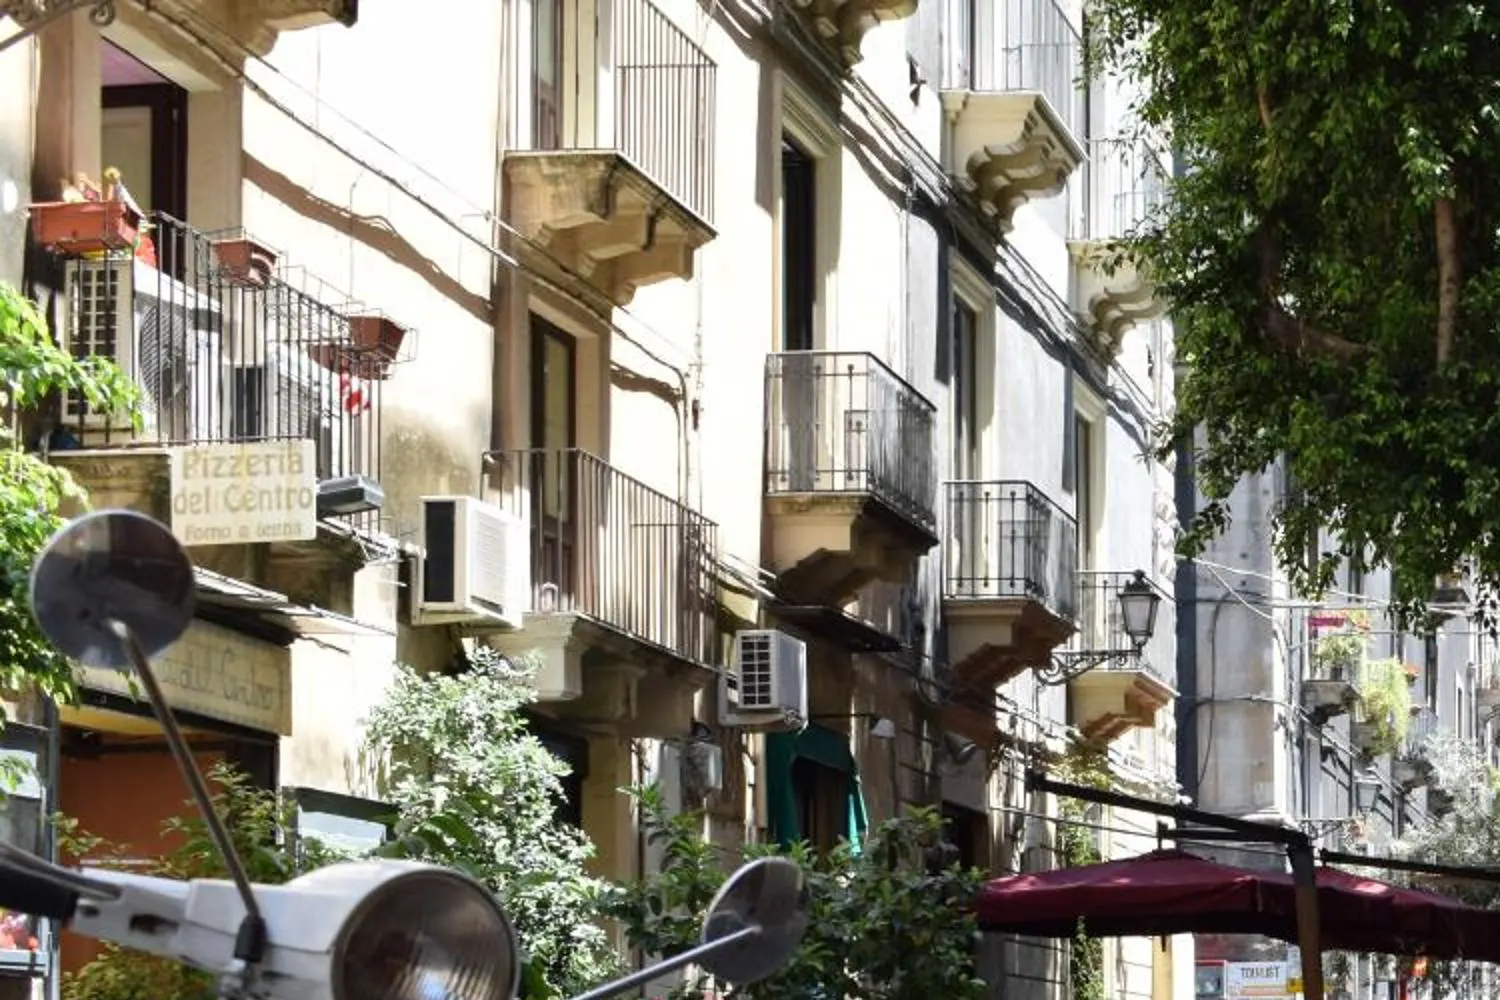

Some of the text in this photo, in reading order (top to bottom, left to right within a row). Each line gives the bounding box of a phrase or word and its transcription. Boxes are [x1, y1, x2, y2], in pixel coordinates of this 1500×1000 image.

[183, 447, 304, 480] Pizzeria
[173, 484, 314, 515] del Centro
